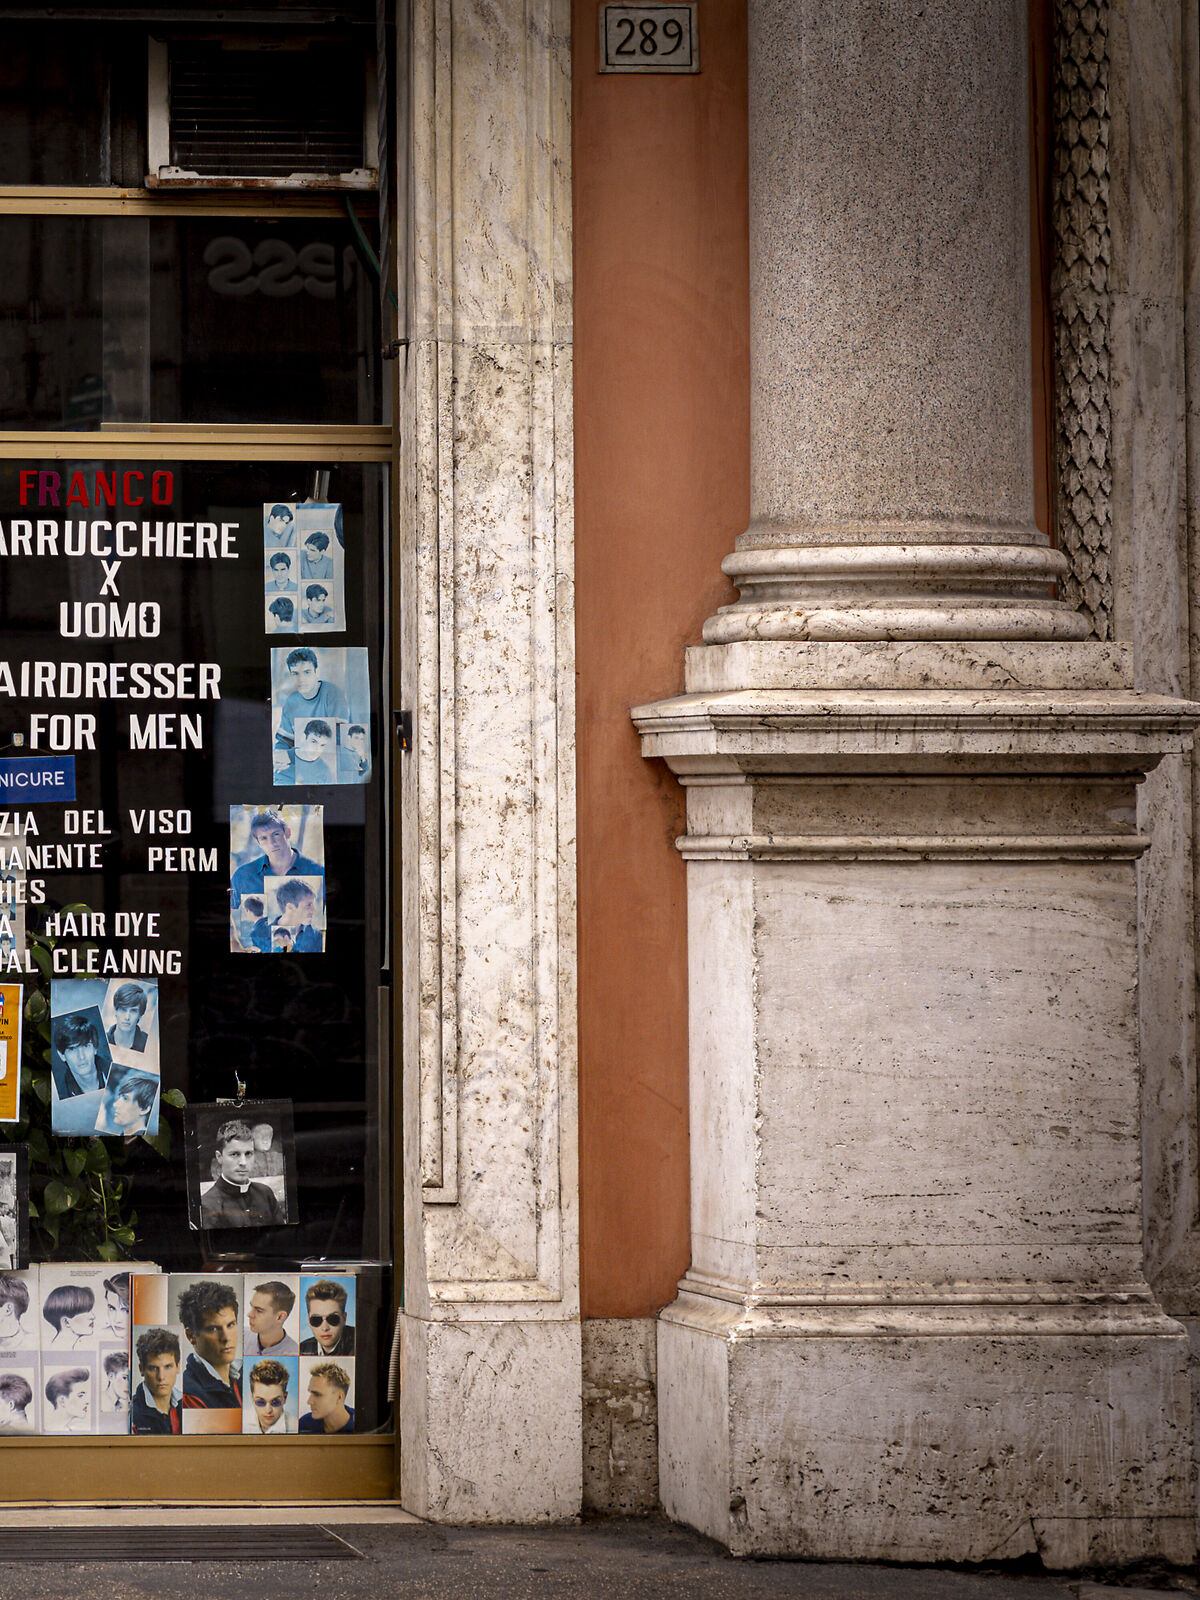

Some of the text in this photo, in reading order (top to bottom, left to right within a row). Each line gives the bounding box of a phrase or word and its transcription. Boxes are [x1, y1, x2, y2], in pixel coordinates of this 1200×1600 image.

[616, 18, 683, 56] 289
[19, 470, 174, 507] FRANCO
[99, 559, 122, 597] X
[60, 601, 161, 638] UOMO
[30, 713, 203, 751] FOR MEN
[64, 810, 112, 834] DEL
[129, 809, 192, 834] VISO
[148, 847, 218, 872] PERM
[45, 912, 106, 937] HAIR
[115, 912, 160, 937] DYE
[53, 948, 182, 975] CLEANING
